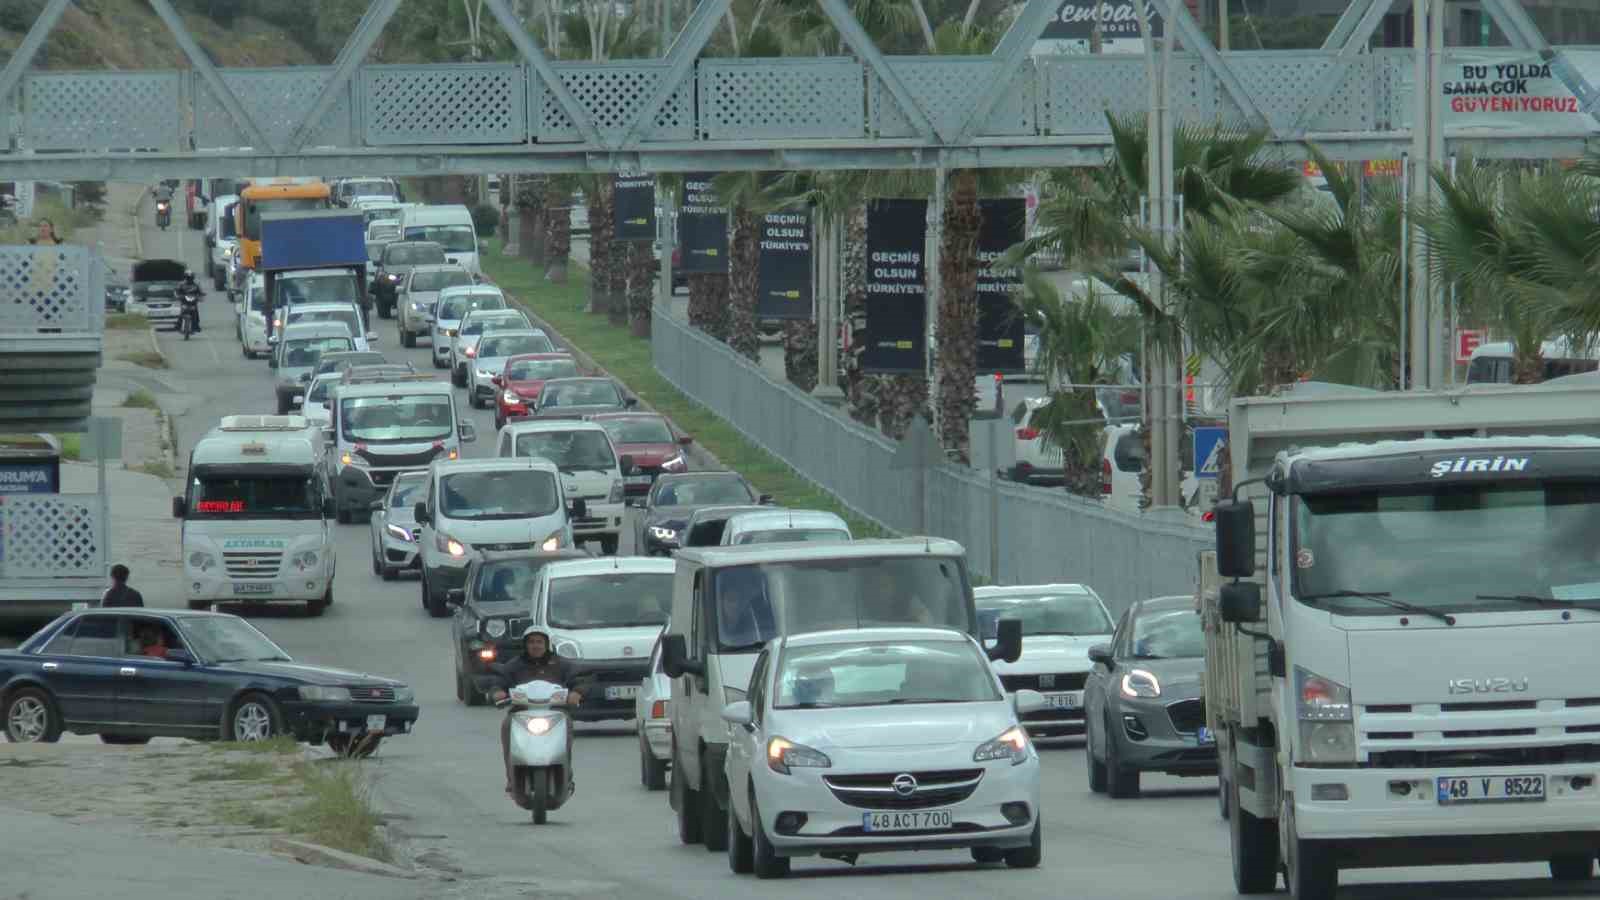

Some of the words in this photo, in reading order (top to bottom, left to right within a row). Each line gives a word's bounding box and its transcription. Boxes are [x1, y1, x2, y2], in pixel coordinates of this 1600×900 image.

[1463, 65, 1487, 79] BU
[1496, 64, 1552, 79] YOLDA
[1442, 81, 1488, 95] SANA
[1451, 96, 1578, 112] GÜVENİYORUZ
[767, 227, 804, 238] OLSUN
[872, 250, 920, 265] GEÇMİŞ
[874, 267, 916, 279] OLSUN
[1431, 456, 1528, 477] ŞİRİN
[1448, 677, 1528, 695] ISUZU
[1450, 780, 1468, 797] 48
[1481, 779, 1490, 796] V
[1504, 777, 1541, 795] 8522
[872, 815, 889, 828] 48
[893, 814, 918, 828] ACT
[924, 812, 949, 826] 700
